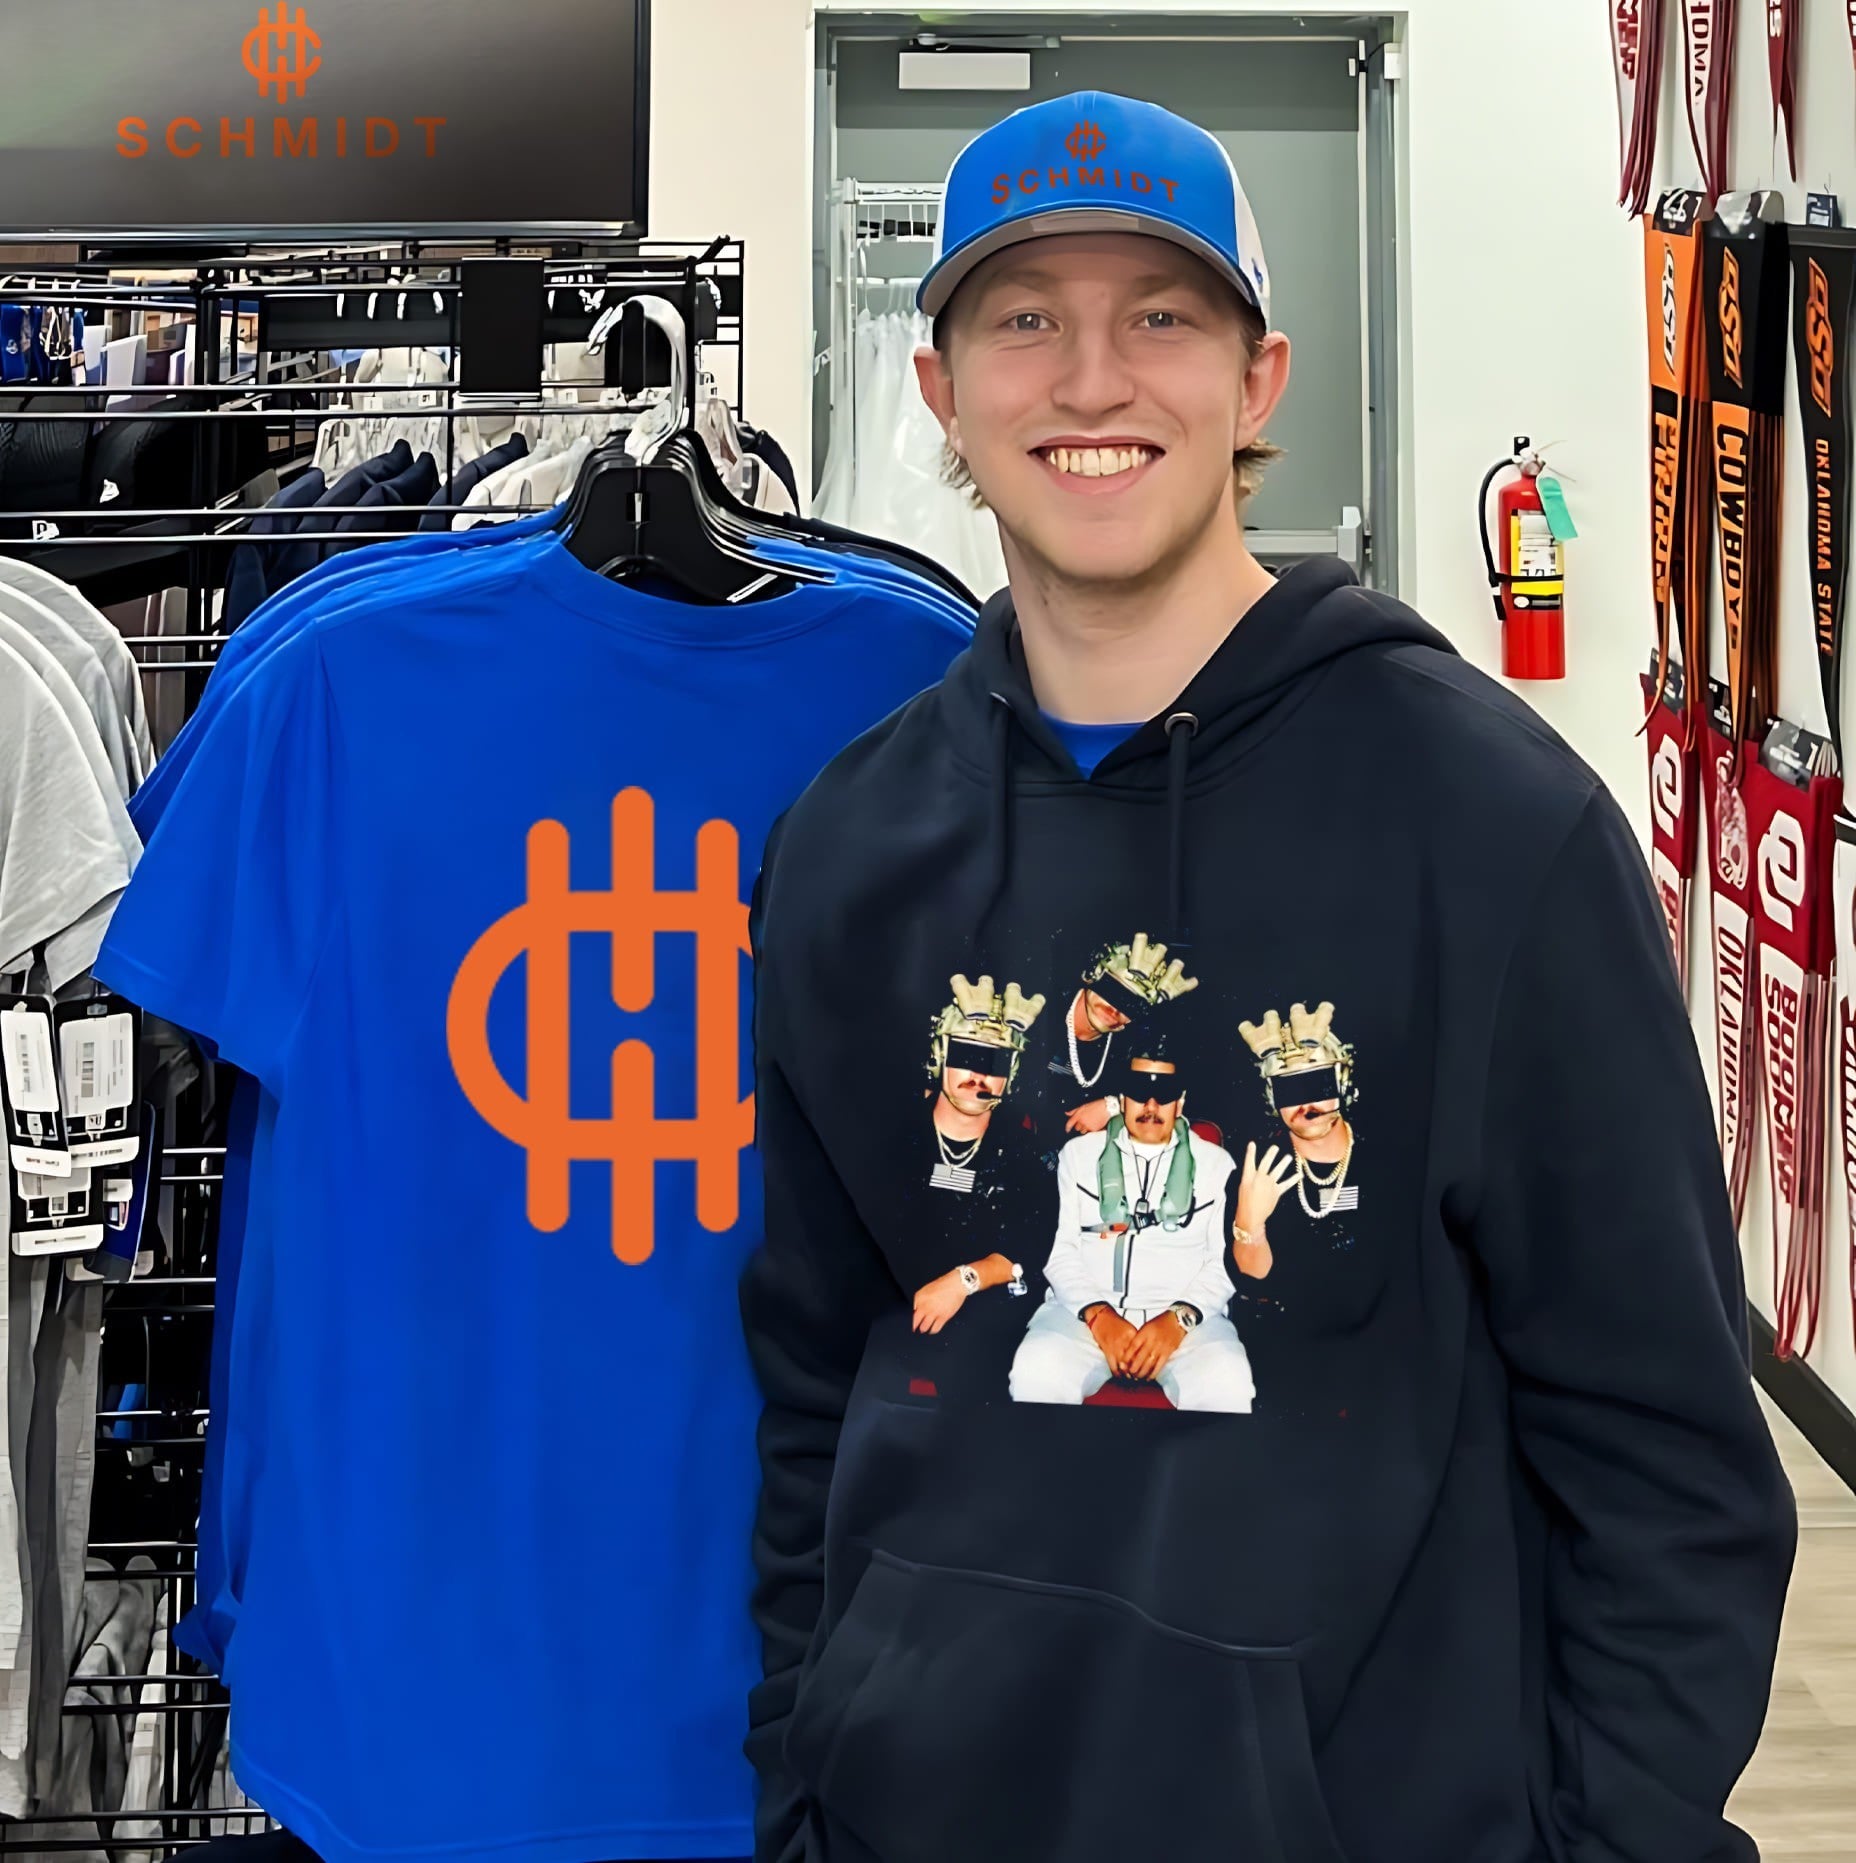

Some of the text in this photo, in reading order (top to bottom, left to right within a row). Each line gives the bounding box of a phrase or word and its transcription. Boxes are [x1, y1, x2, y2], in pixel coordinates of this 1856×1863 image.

[115, 116, 448, 158] SCHMIDT
[991, 166, 1180, 204] SCHMIDT
[1815, 438, 1832, 571] OKLAHOMA
[1718, 926, 1745, 1145] OKLAHOMA
